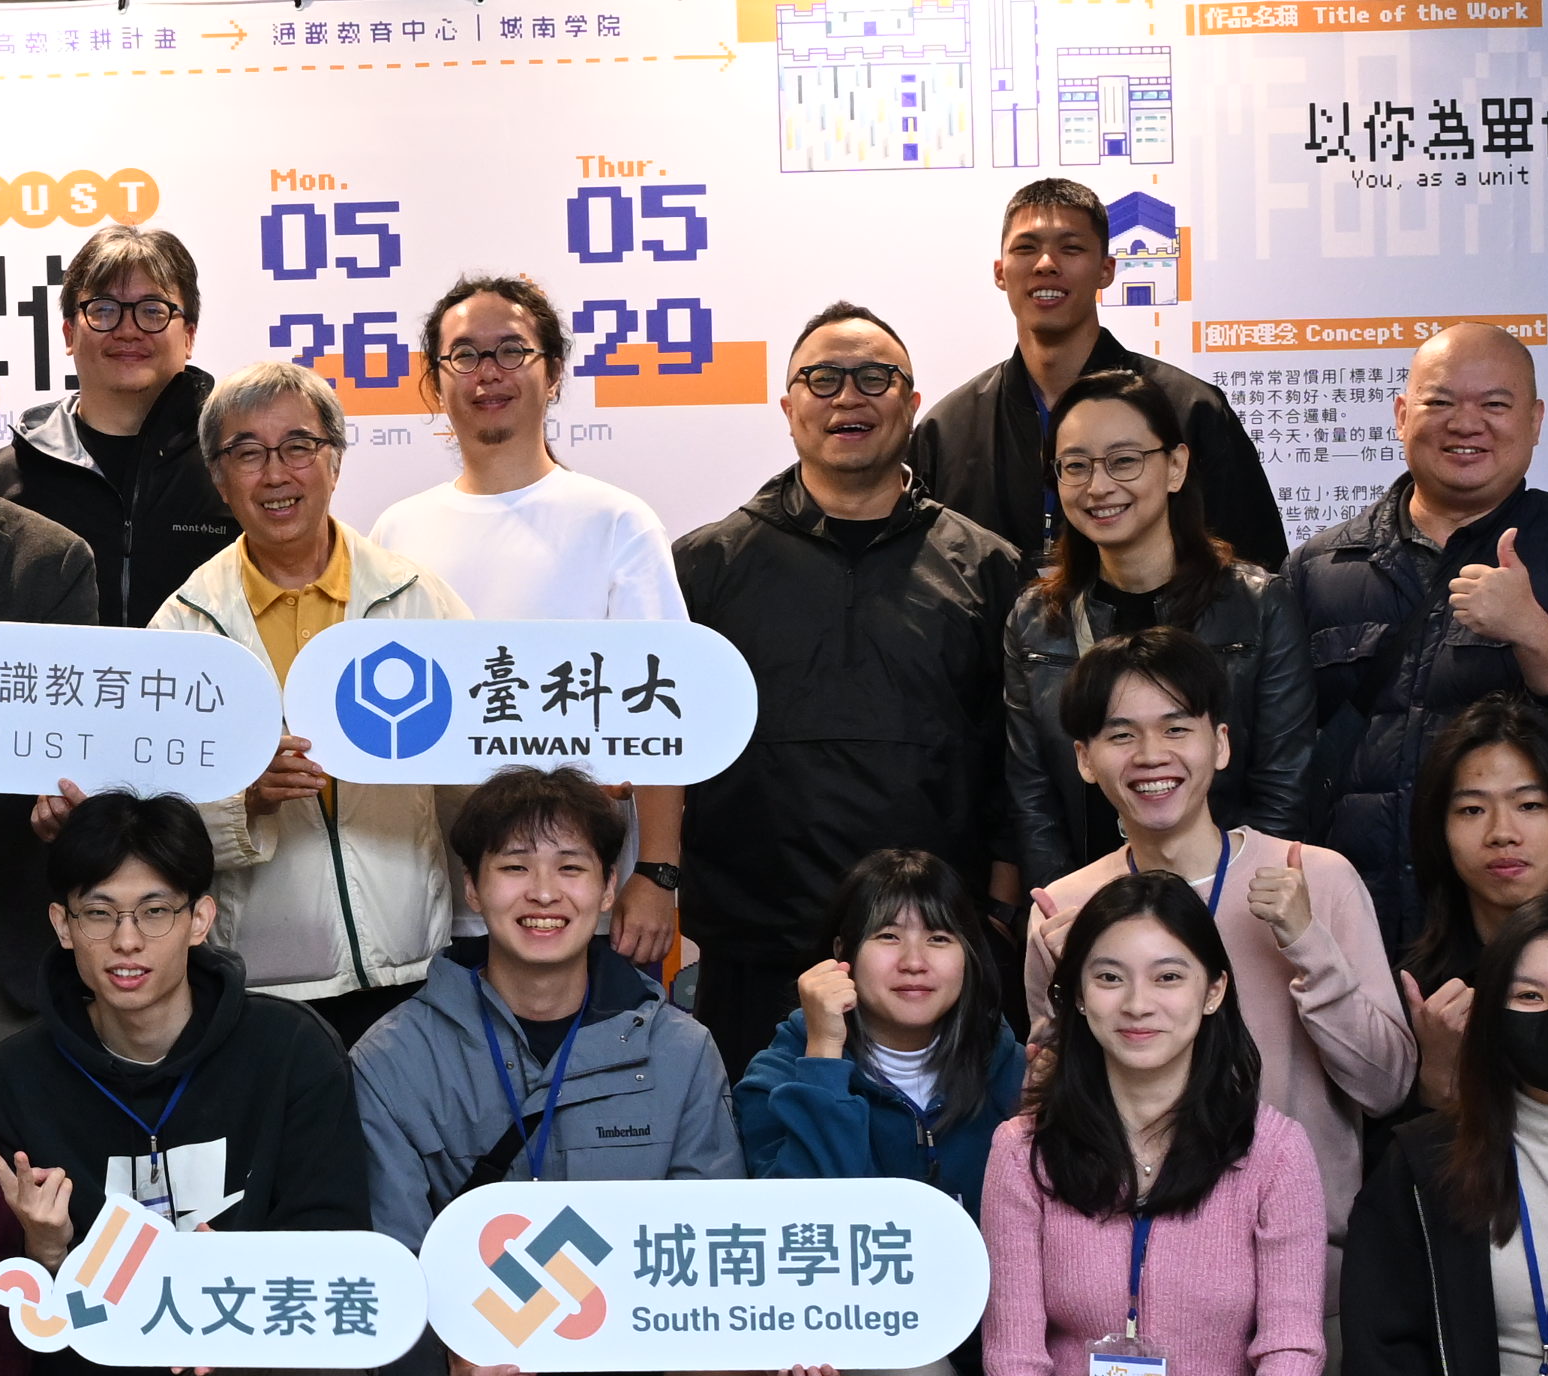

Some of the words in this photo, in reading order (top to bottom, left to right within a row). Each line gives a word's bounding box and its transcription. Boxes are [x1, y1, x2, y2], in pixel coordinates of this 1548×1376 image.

[1312, 4, 1371, 25] Title
[1379, 3, 1408, 23] of
[1416, 2, 1458, 22] the
[1466, 0, 1530, 21] Work
[269, 168, 350, 192] Mon.
[575, 155, 668, 179] Thur.
[1416, 169, 1442, 188] as
[1455, 170, 1467, 187] a
[1479, 164, 1531, 186] unit
[566, 183, 709, 264] 05
[260, 200, 402, 281] 05
[572, 297, 714, 377] 29
[1306, 322, 1405, 344] Concept
[1414, 318, 1547, 340] Stent
[269, 311, 410, 390] 26
[370, 427, 411, 446] am
[570, 423, 613, 447] pm
[468, 645, 683, 732] 臺科大
[133, 736, 217, 768] CGE
[467, 735, 592, 756] TAIWAN
[603, 736, 684, 757] TECH
[595, 1123, 651, 1139] Timberland
[632, 1221, 915, 1288] 城南學院
[140, 1275, 379, 1337] 人文素養
[631, 1306, 721, 1333] South
[728, 1305, 795, 1332] Side
[803, 1304, 920, 1338] College
